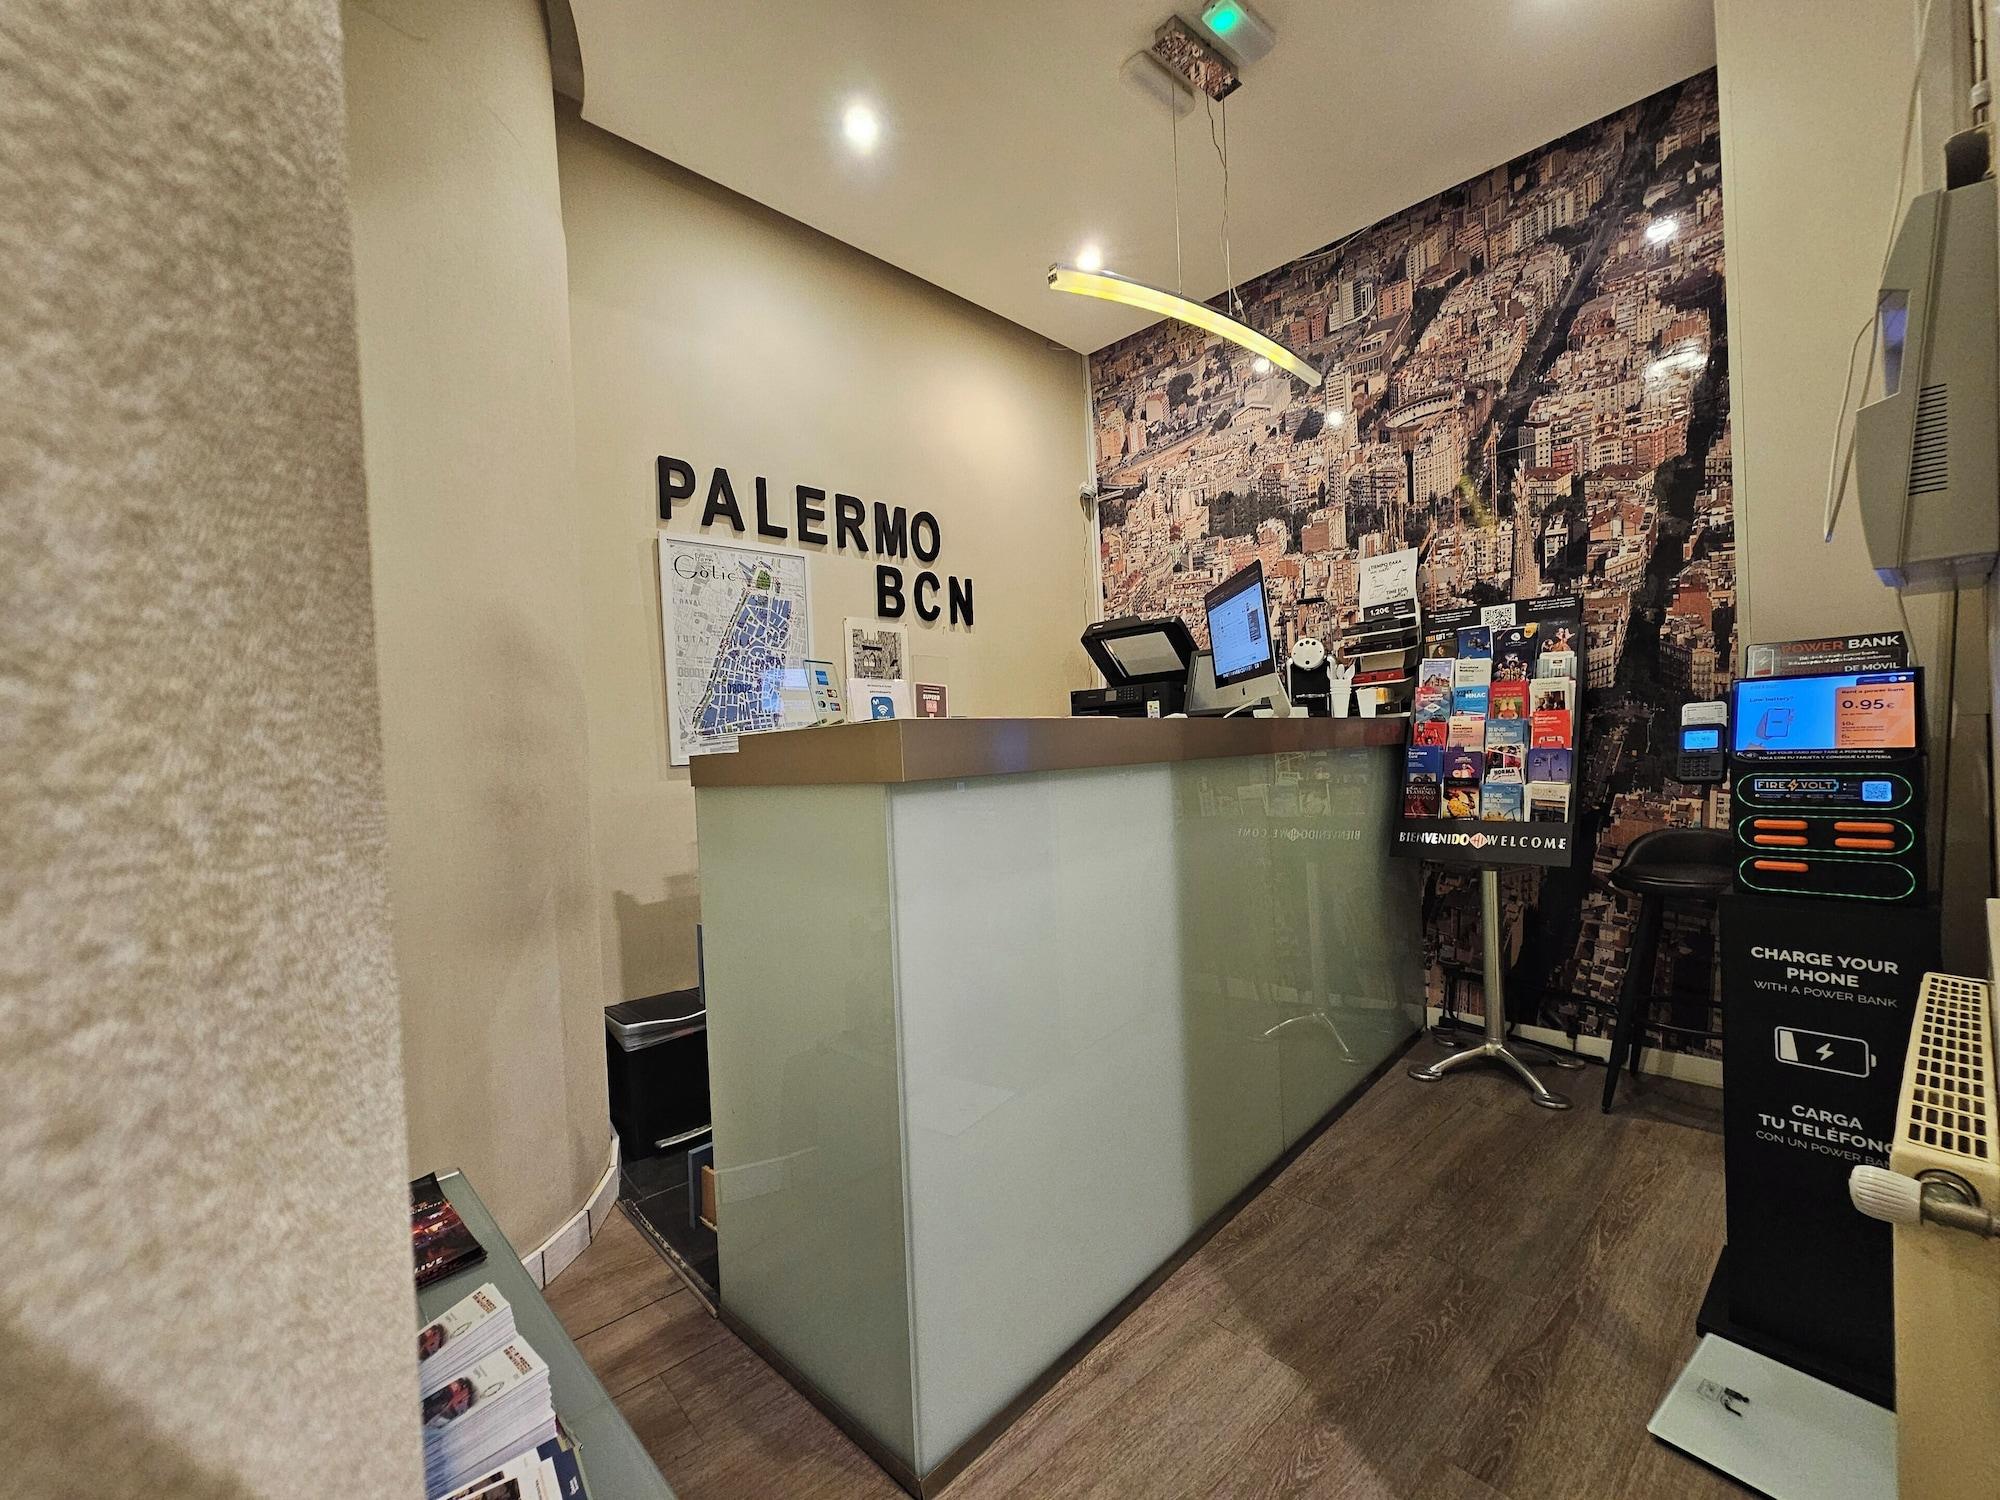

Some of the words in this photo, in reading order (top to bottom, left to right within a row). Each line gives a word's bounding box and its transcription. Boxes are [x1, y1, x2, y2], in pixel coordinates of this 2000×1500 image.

[657, 455, 941, 563] PALERMO
[875, 564, 974, 626] BCN
[1369, 606, 1389, 616] 1,20€
[1781, 640, 1844, 654] POWER
[1848, 635, 1900, 649] BANK
[1844, 664, 1860, 672] DE
[1862, 661, 1901, 671] MÓVIL
[1757, 781, 1785, 789] FIRE
[1801, 781, 1832, 789] VOLT
[1399, 831, 1470, 846] BIENVENIDO
[1485, 834, 1567, 850] WELCOME
[1750, 946, 1833, 967] CHARGE
[1837, 956, 1900, 975] YOUR
[1786, 967, 1860, 988] PHONE
[1753, 980, 1788, 993] WITH
[1791, 985, 1801, 994] A
[1804, 987, 1854, 1002] POWER
[1858, 994, 1898, 1008] BANK
[1758, 1113, 1785, 1129] TU
[1791, 1104, 1863, 1130] CARGA
[1755, 1130, 1784, 1144] CON
[1787, 1136, 1808, 1149] UN
[1811, 1143, 1861, 1163] POWER
[414, 1257, 443, 1274] LIVE
